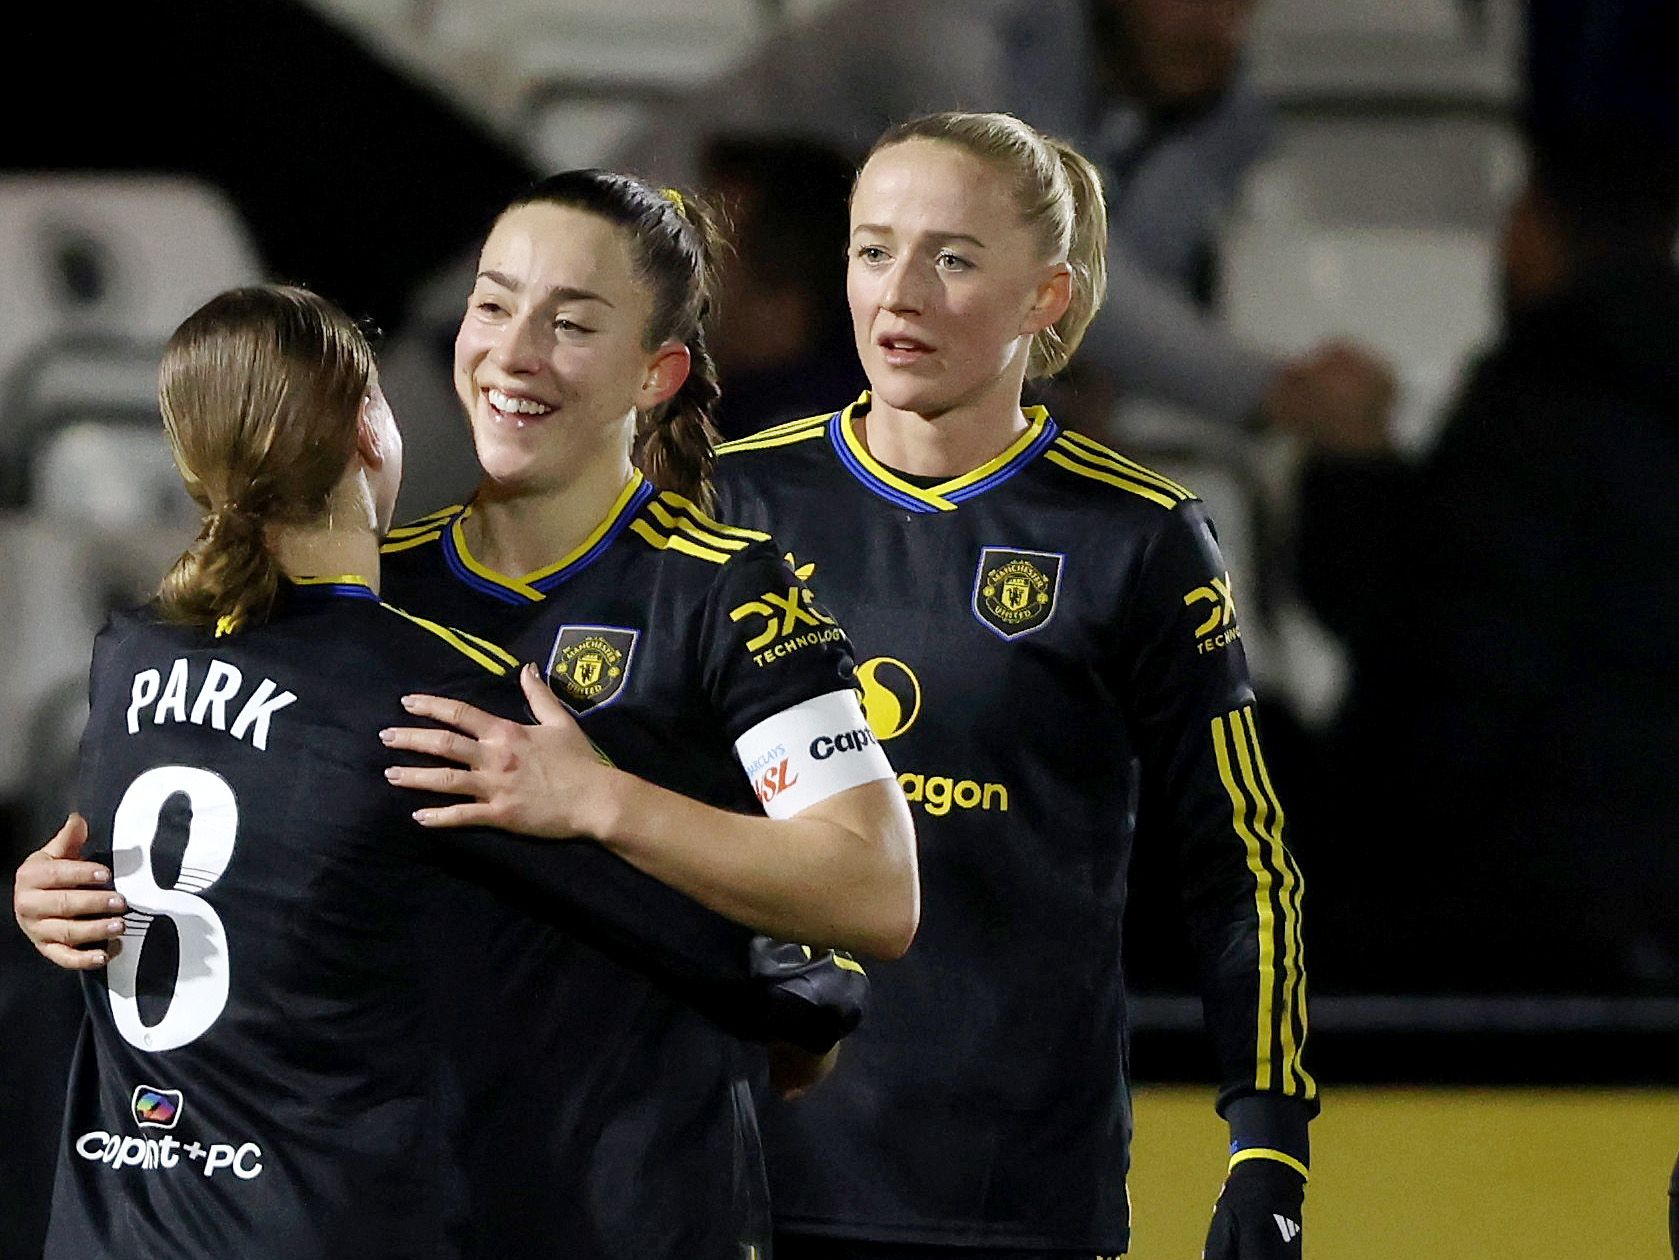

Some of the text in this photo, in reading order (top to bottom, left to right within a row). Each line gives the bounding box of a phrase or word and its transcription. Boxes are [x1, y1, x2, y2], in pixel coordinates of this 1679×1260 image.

[753, 627, 846, 667] TECHNOLOG
[127, 657, 297, 751] PARK
[746, 743, 786, 777] ARCLAYS
[107, 765, 239, 1052] 8
